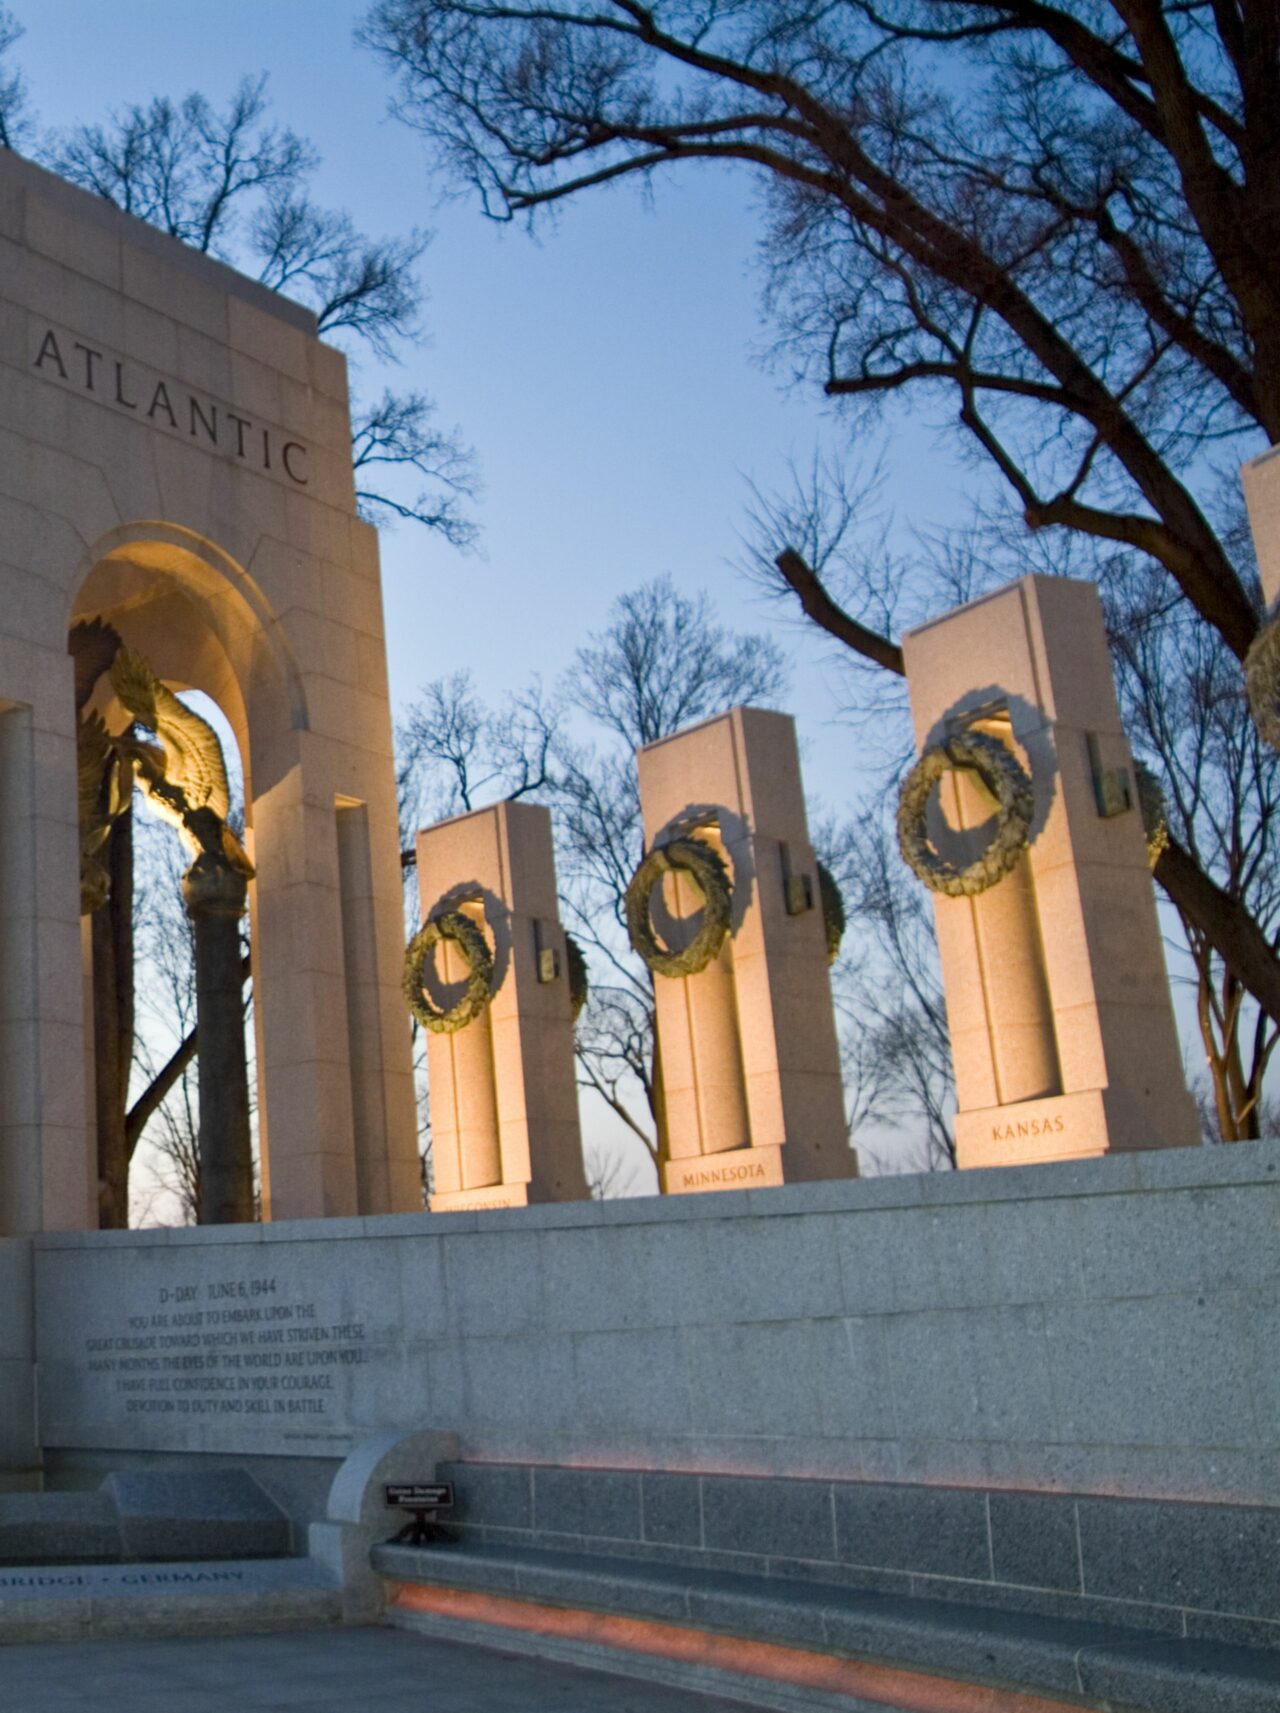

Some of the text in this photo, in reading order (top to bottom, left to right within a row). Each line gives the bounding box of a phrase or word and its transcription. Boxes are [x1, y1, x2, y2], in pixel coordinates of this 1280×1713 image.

[33, 329, 310, 486] ATLANTIC
[992, 1115, 1065, 1141] KANSAS
[682, 1163, 766, 1188] MINNESOTA
[159, 1286, 198, 1303] D-DAY
[208, 1281, 235, 1300] JUNE
[250, 1278, 276, 1296] 1944
[128, 1303, 316, 1329] YOU ARE ABOUT TO EMBARK UPON THE
[159, 1333, 200, 1349] TOWARD
[201, 1331, 238, 1347] WHICH
[239, 1330, 254, 1345] WE
[258, 1328, 285, 1343] HAVE
[287, 1326, 329, 1342] STRIVEN
[332, 1324, 365, 1340] THESE
[206, 1354, 219, 1368] OF
[222, 1353, 240, 1368] THE
[243, 1352, 281, 1367] WORLD
[284, 1351, 305, 1366] ARE
[307, 1350, 337, 1365] UPON
[172, 1376, 235, 1391] CONFIDENCE
[238, 1376, 249, 1390] IN
[251, 1376, 278, 1391] YOUR
[177, 1399, 189, 1413] TO
[220, 1399, 242, 1413] AND
[244, 1399, 270, 1413] SKILL
[273, 1399, 285, 1413] IN
[121, 1570, 246, 1586] GERMANY
